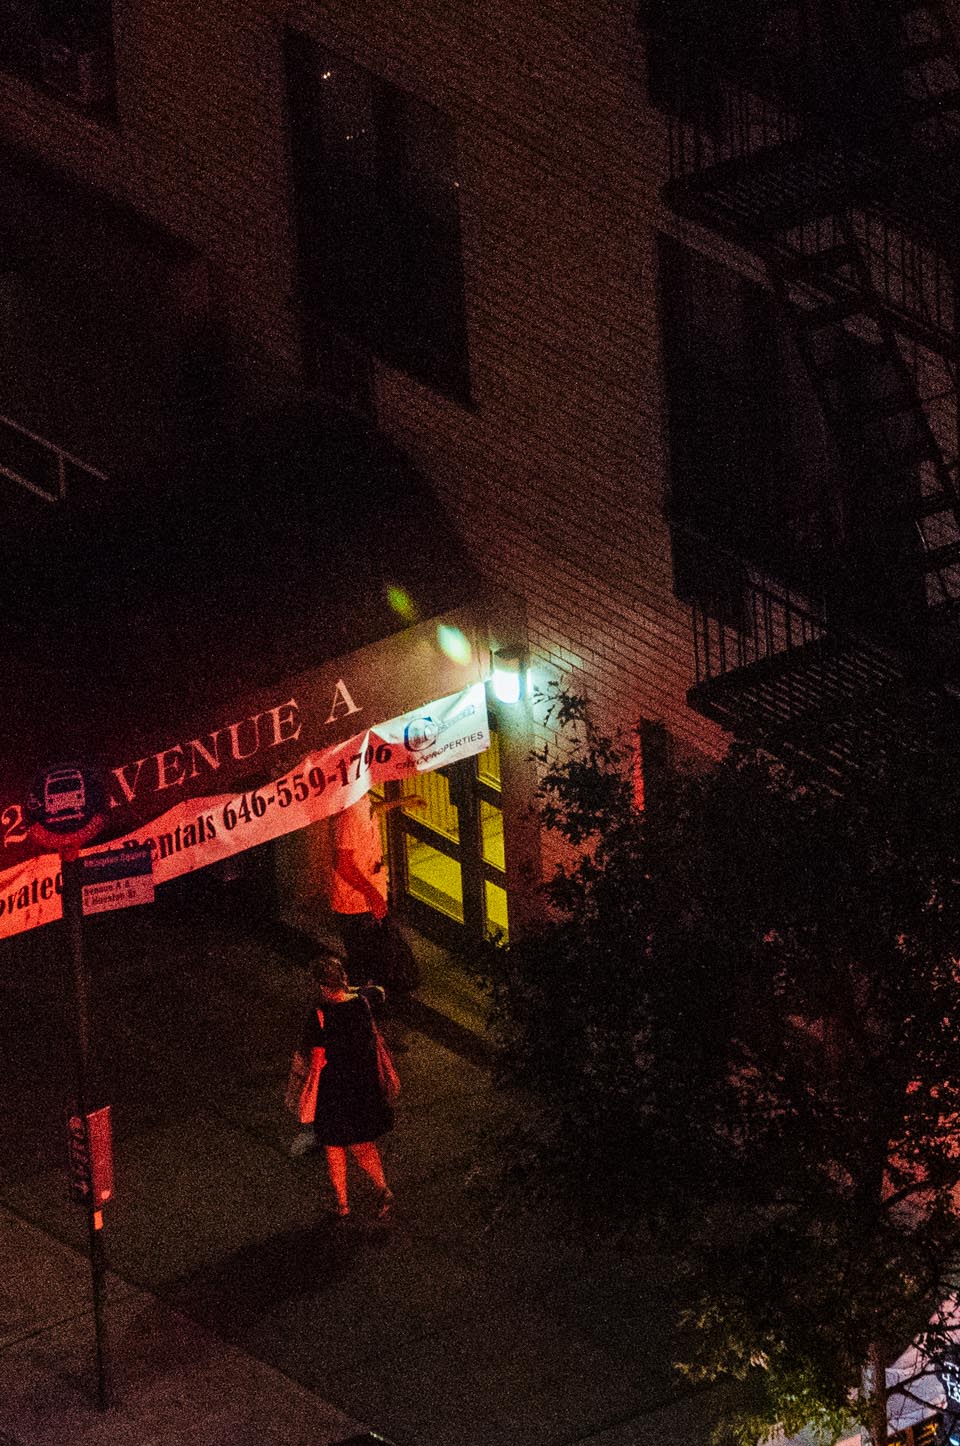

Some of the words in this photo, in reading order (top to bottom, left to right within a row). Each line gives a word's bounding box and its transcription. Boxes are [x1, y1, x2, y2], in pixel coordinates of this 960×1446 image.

[104, 698, 302, 808] VENUE
[324, 679, 363, 724] A
[222, 743, 393, 831] 646-559-1796
